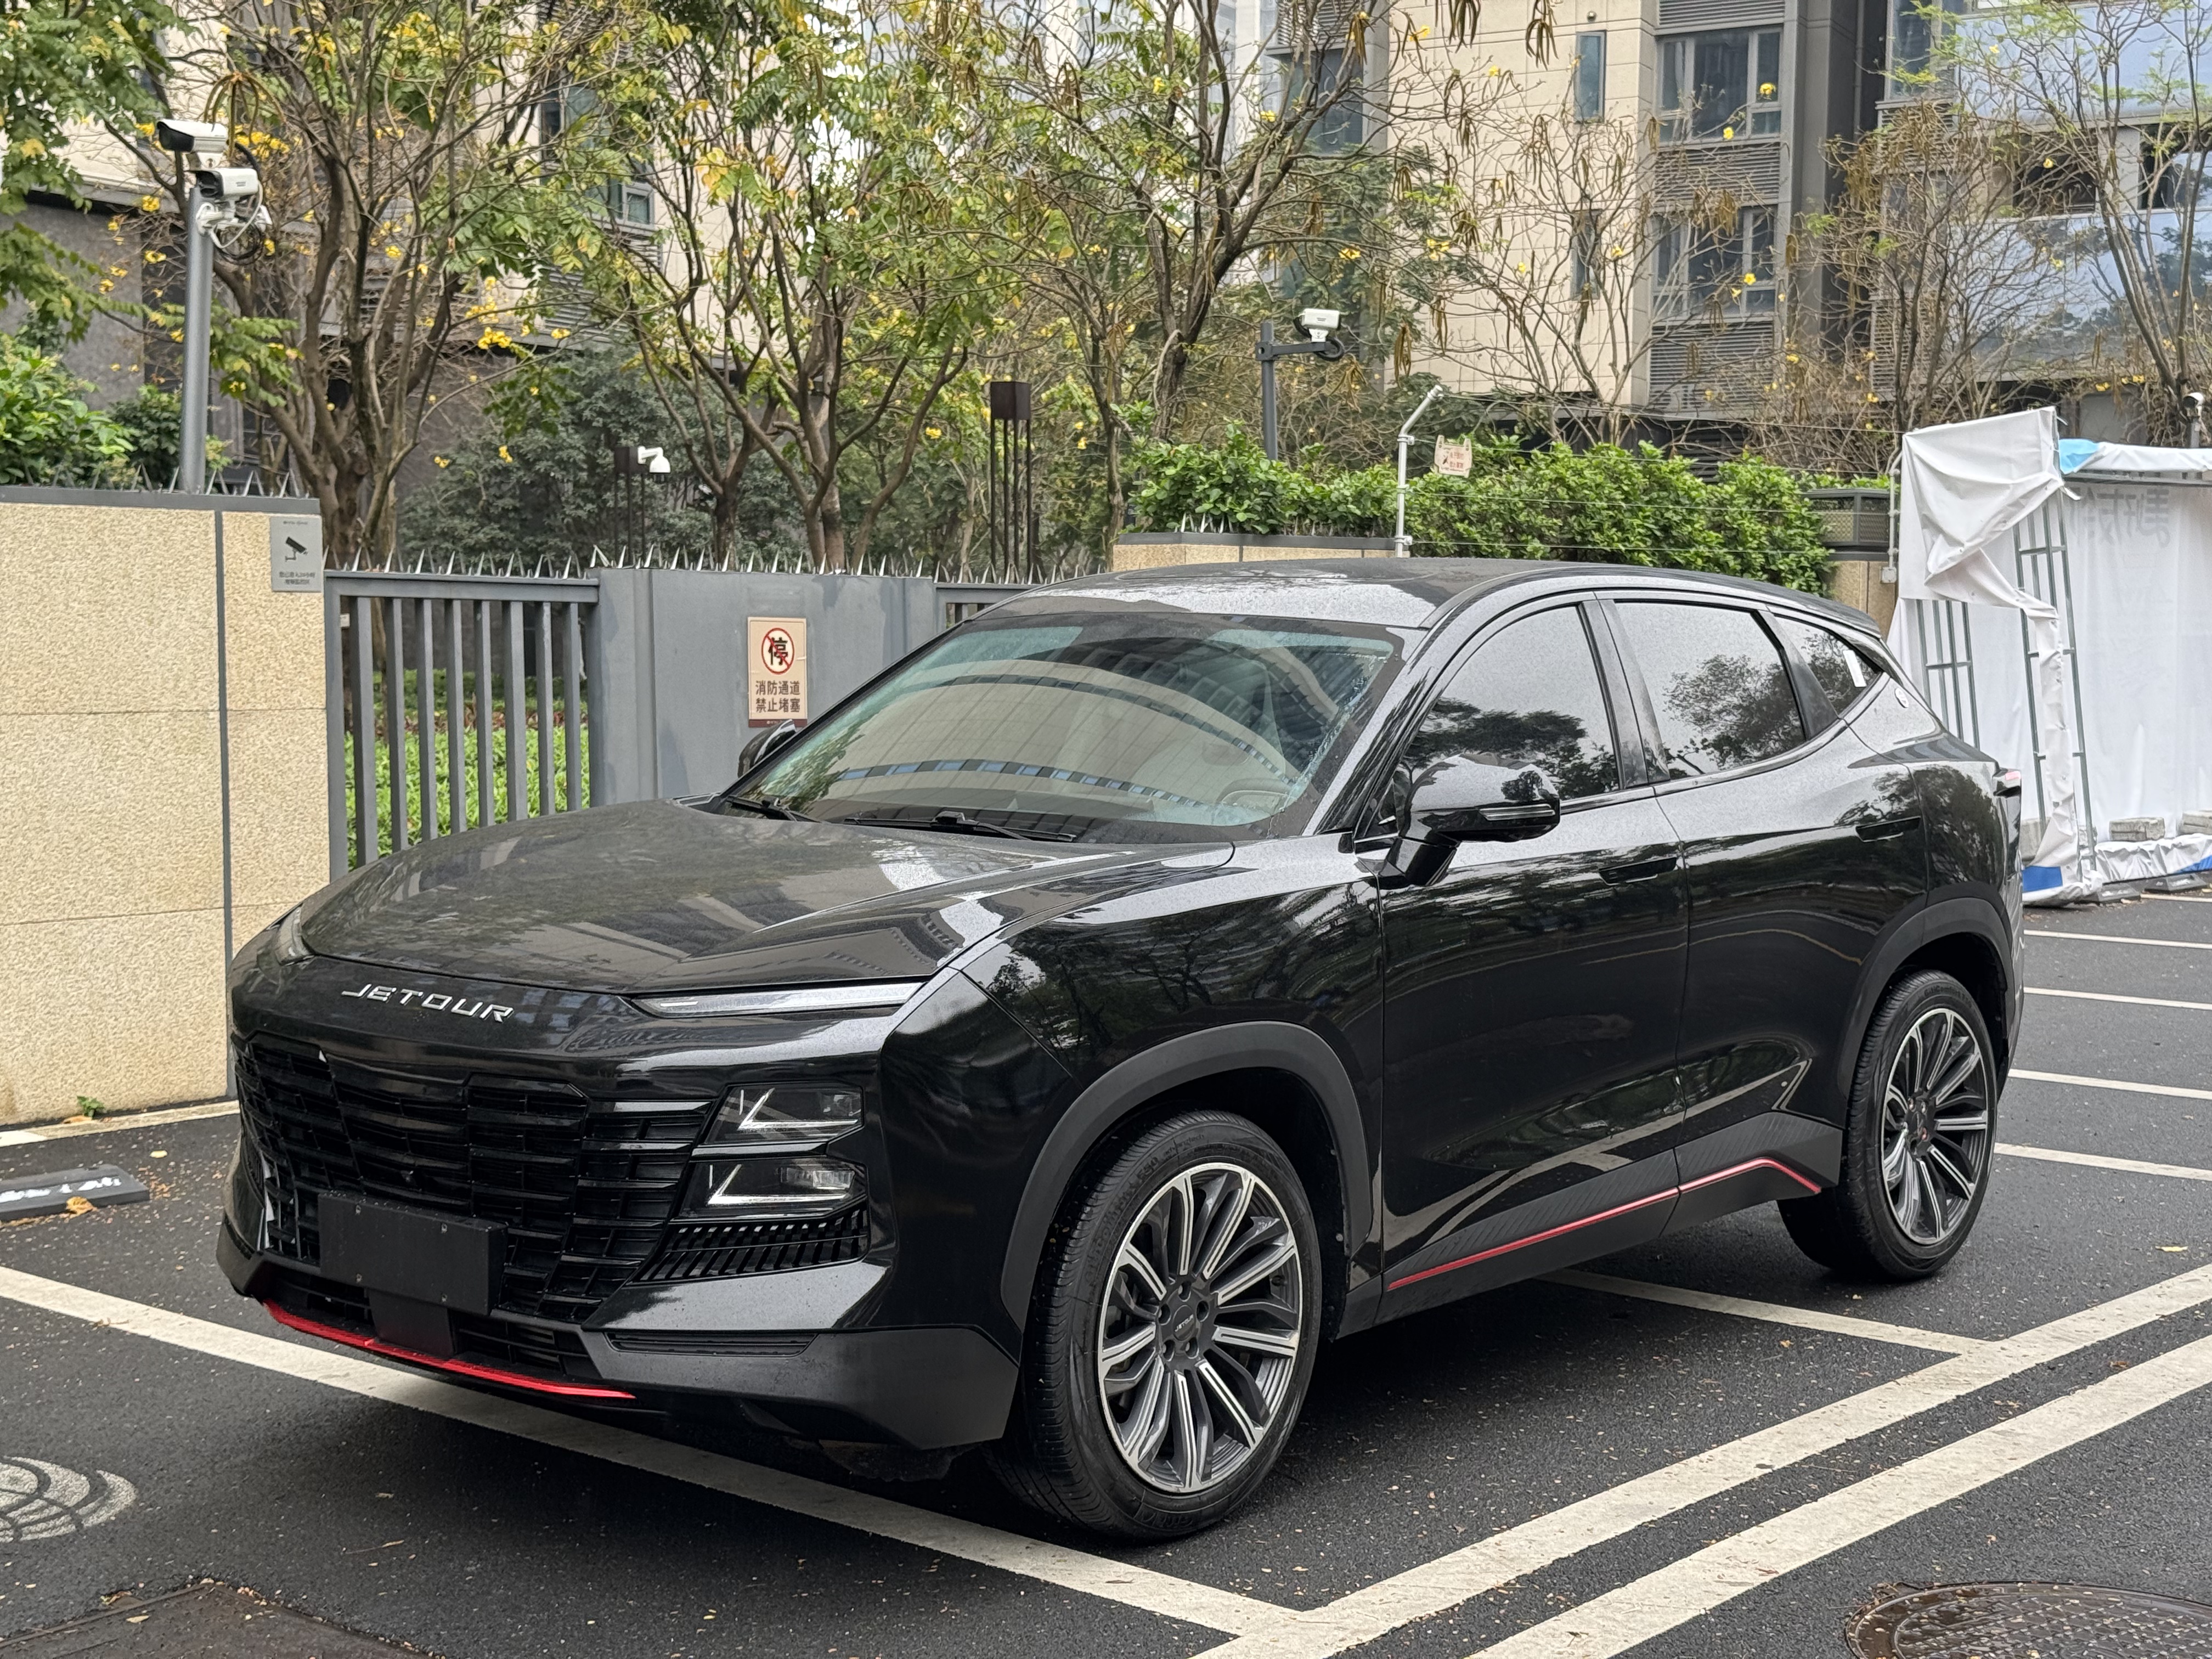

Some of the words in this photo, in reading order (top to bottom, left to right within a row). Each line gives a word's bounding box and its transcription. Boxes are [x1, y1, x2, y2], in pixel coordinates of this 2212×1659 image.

[768, 637, 788, 666] 停
[755, 680, 800, 695] 消防通道
[755, 698, 800, 713] 禁止堵塞
[341, 983, 515, 1023] JETOUR
